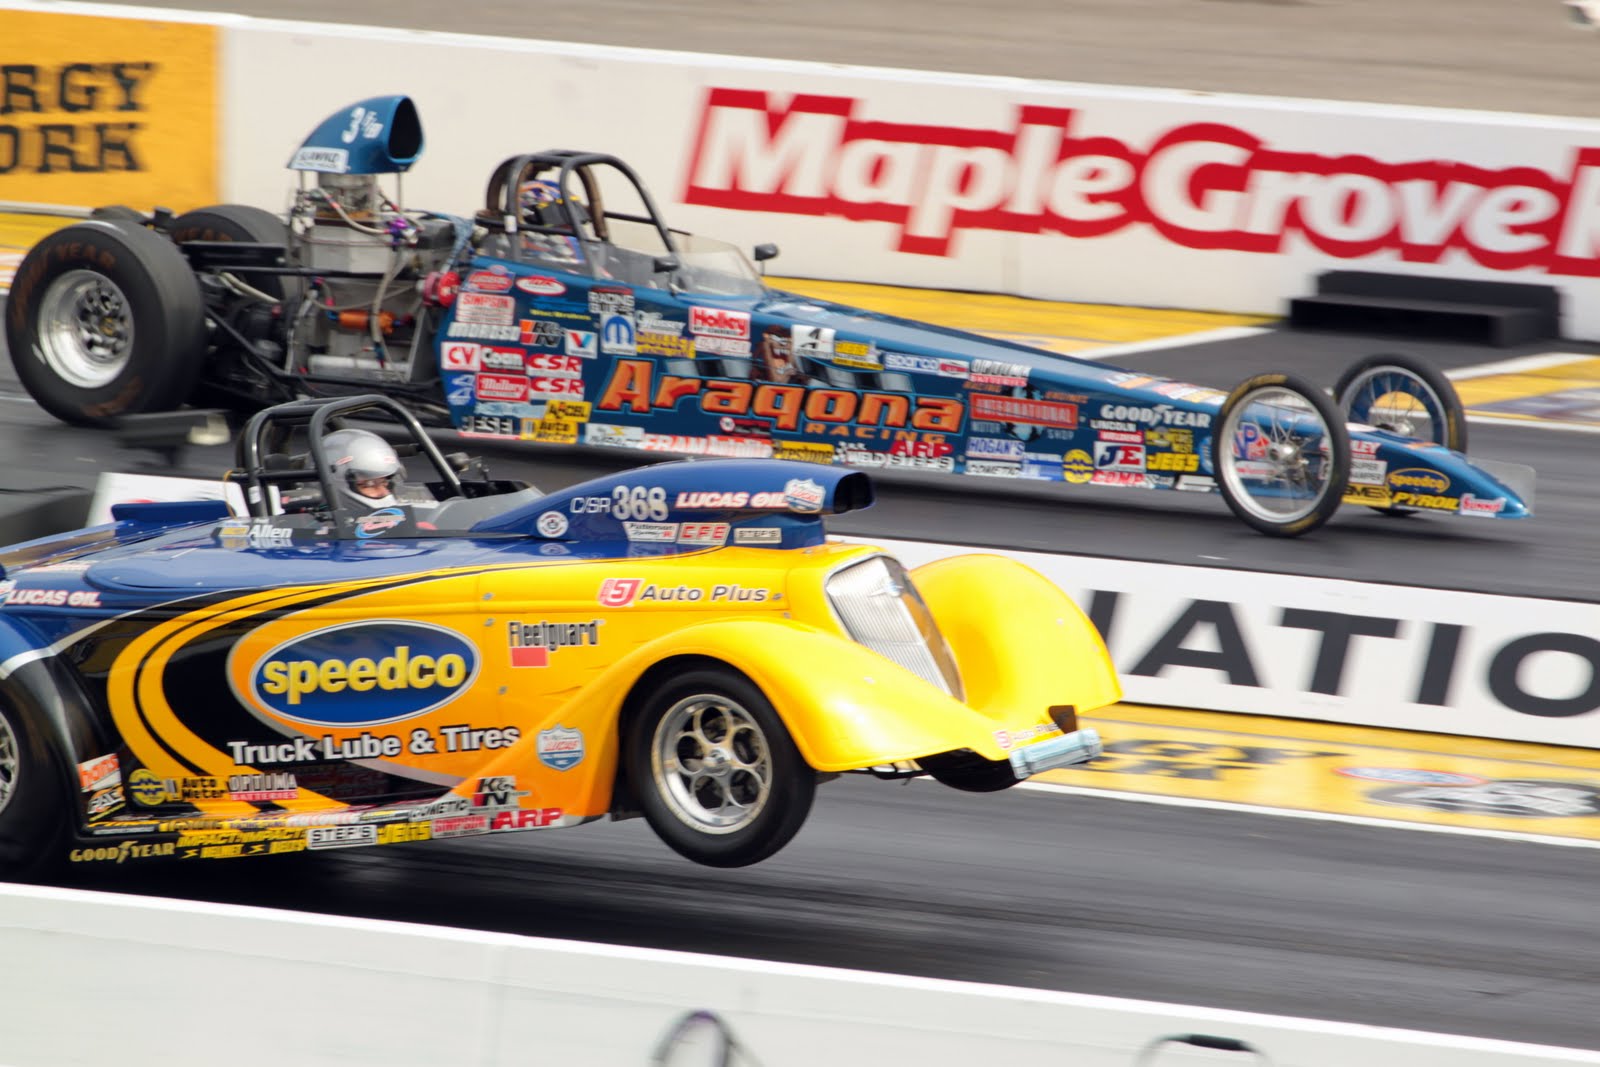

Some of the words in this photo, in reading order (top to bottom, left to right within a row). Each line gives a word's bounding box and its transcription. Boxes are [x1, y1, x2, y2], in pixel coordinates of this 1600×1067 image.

[527, 353, 583, 373] CSR
[530, 376, 586, 395] CSR
[804, 423, 947, 444] RACING
[891, 439, 953, 459] ARP
[612, 485, 669, 521] 368
[675, 492, 750, 508] LUCAS
[751, 492, 790, 508] OIL
[1392, 492, 1459, 511] PYROIL
[250, 523, 293, 539] Allen
[681, 525, 727, 540] CFE
[5, 589, 68, 606] LUCAS
[640, 585, 702, 602] Auto
[711, 585, 769, 602] Plus
[509, 620, 600, 651] Fleetguard
[262, 645, 467, 705] speedco
[227, 737, 316, 766] Truck
[322, 733, 402, 759] Lube
[408, 728, 439, 754] &
[441, 725, 520, 751] Tires
[228, 772, 299, 793] OPTIMA
[490, 807, 565, 830] ARP
